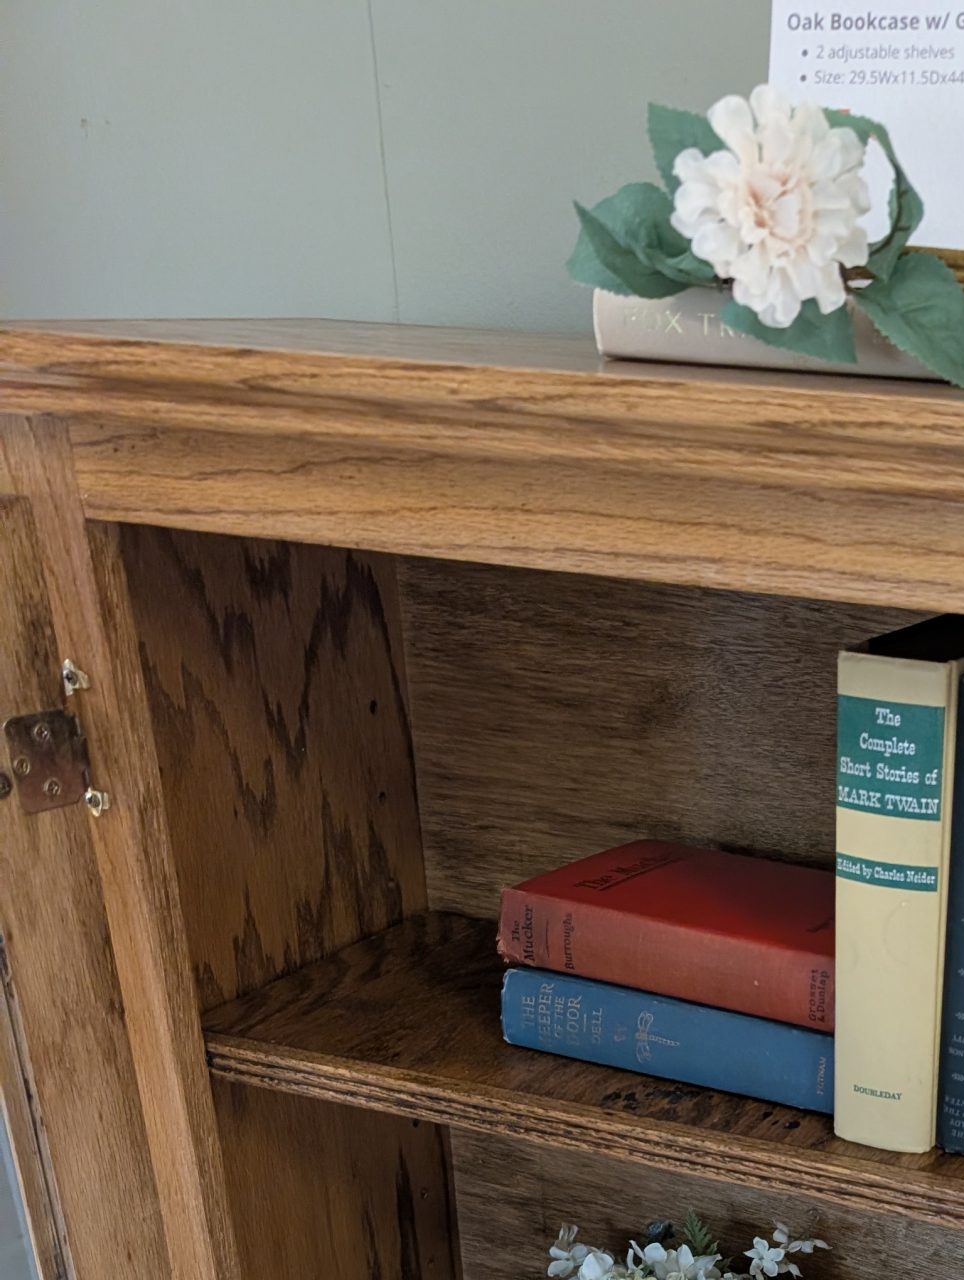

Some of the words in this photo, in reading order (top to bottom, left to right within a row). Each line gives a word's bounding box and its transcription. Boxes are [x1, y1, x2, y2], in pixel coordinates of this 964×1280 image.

[787, 12, 825, 31] Oak
[830, 11, 920, 31] Bookcase
[925, 12, 951, 30] w/
[815, 45, 825, 59] 2
[828, 44, 900, 63] adjustable
[904, 44, 955, 59] shelves
[814, 70, 845, 84] Size:
[875, 707, 901, 726] The
[860, 732, 916, 757] Complete
[840, 756, 872, 778] Short
[876, 763, 919, 784] Stories
[925, 769, 938, 785] of
[838, 785, 881, 808] MARK
[885, 794, 939, 814] TWAIN
[836, 858, 860, 875] Edited
[862, 864, 873, 879] by
[874, 866, 905, 882] Charles
[907, 870, 936, 884] Neider
[512, 920, 521, 942] The
[522, 904, 535, 962] Mucker
[563, 912, 576, 970] Burroughs
[808, 968, 818, 1022] Grosset
[817, 970, 831, 1013] Dunlap
[522, 996, 536, 1028] THE
[555, 996, 565, 1019] THE
[566, 995, 582, 1046] DOOR
[853, 1084, 903, 1101] DOUBLEDAY
